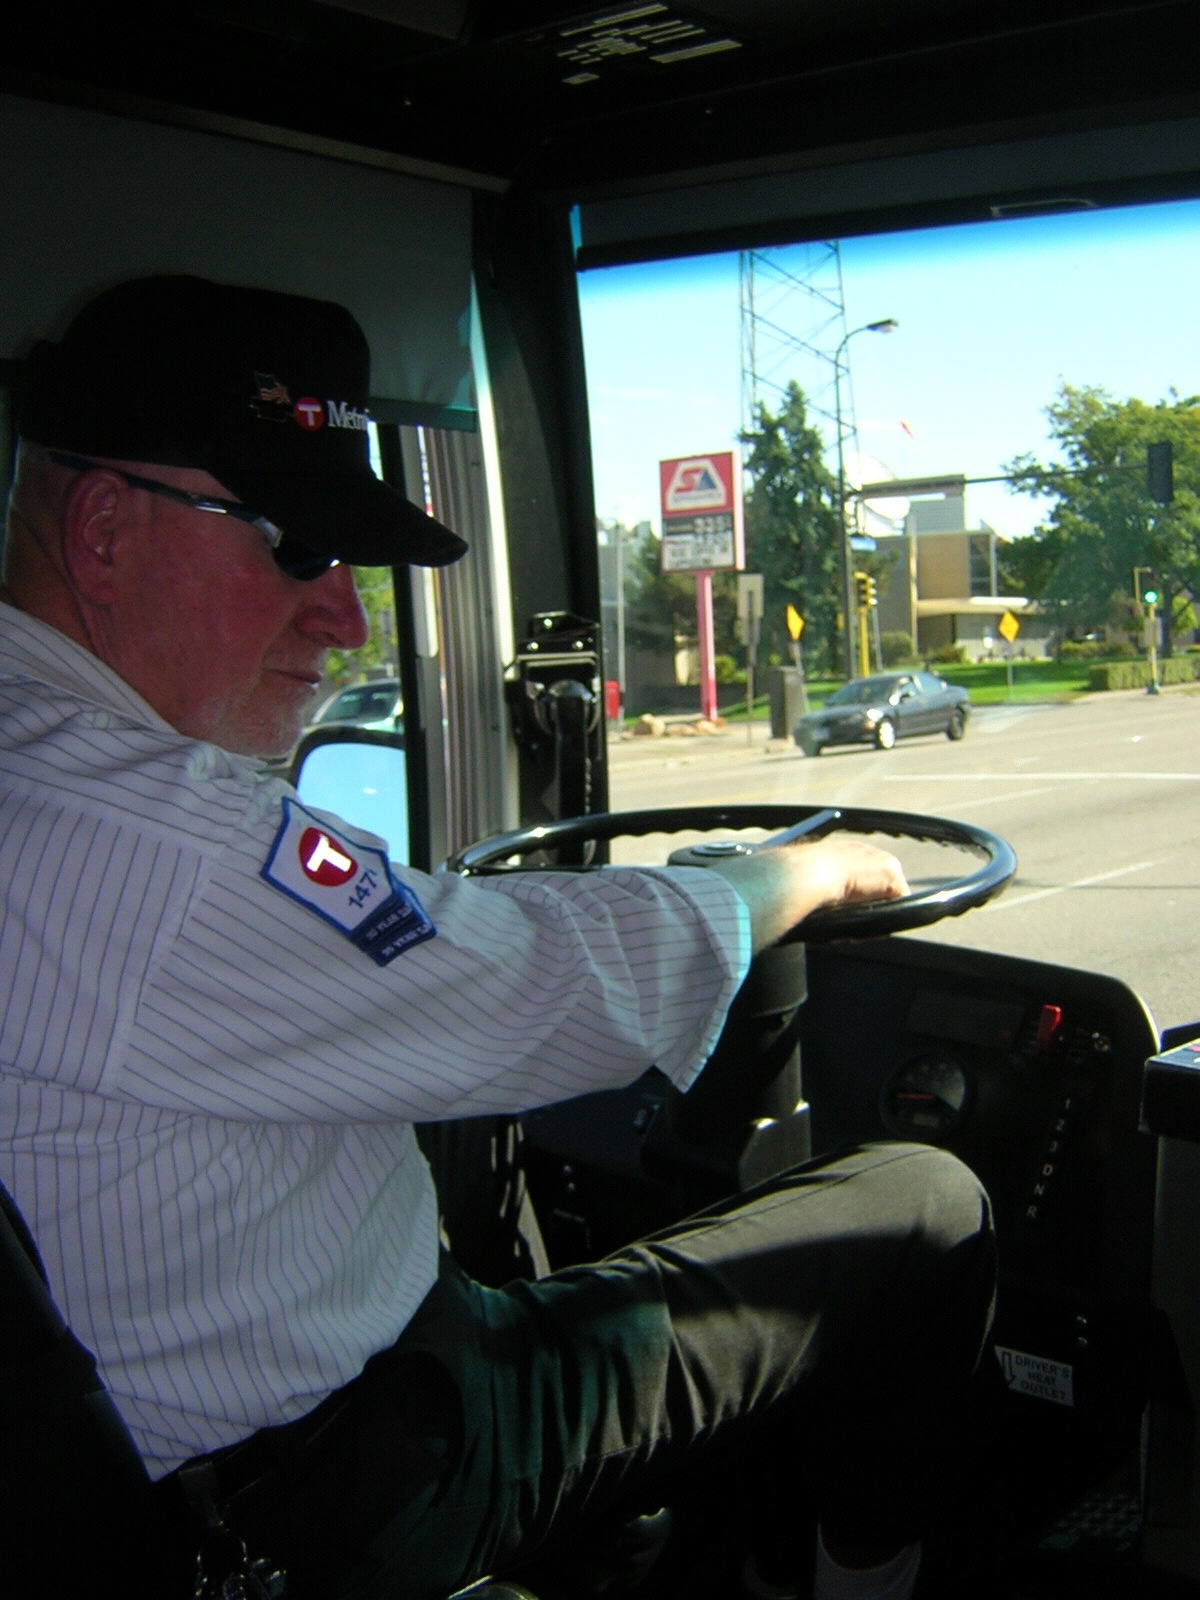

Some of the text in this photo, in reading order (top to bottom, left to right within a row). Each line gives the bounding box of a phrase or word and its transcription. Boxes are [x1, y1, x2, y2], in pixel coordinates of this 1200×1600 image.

[1016, 1355, 1070, 1379] DRIVER'S
[1028, 1371, 1056, 1386] HEAT
[1021, 1380, 1066, 1399] OUTLET
